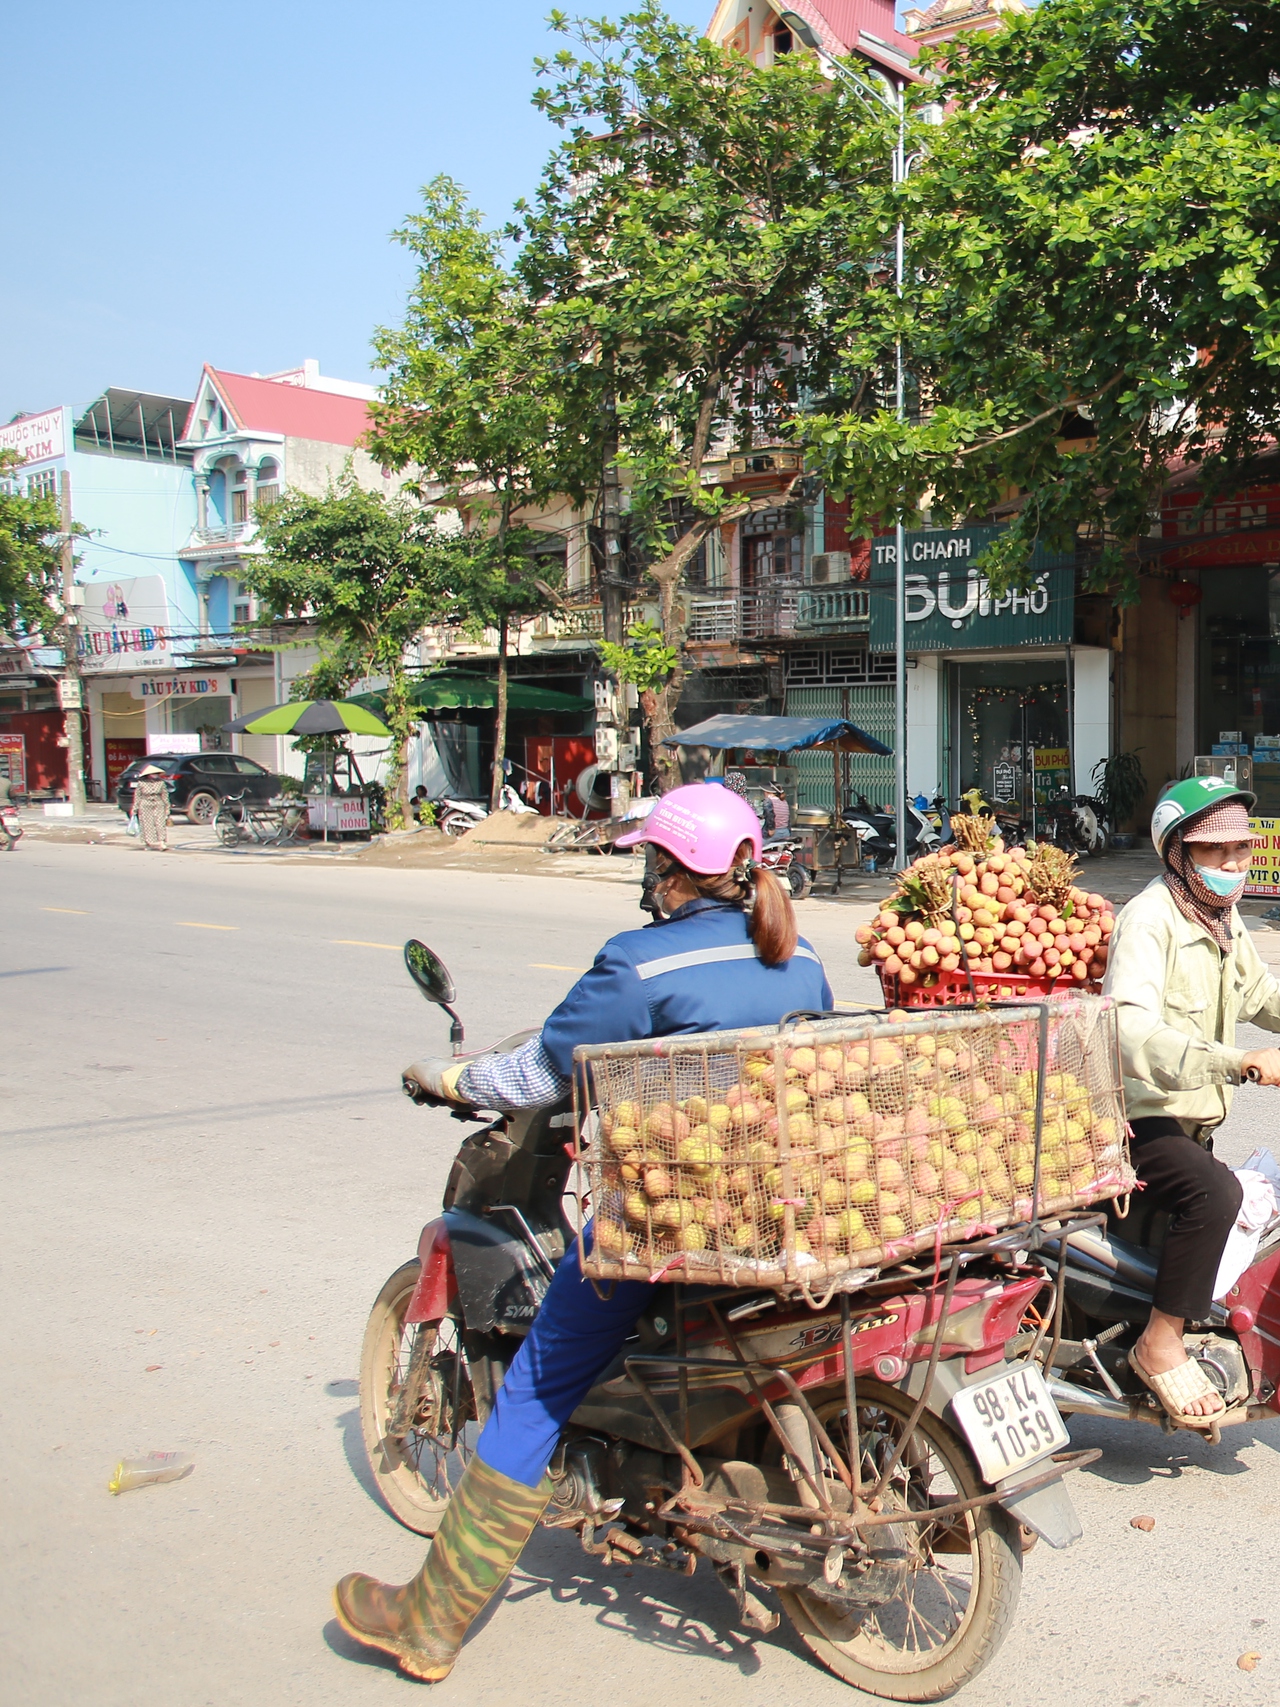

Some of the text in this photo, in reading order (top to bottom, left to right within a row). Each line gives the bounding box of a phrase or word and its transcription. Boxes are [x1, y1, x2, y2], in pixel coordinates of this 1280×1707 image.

[25, 440, 53, 460] KIM
[912, 538, 970, 561] CHANH
[1217, 541, 1260, 556] GIA
[995, 572, 1049, 615] PHỐ
[104, 623, 129, 653] TÂY
[132, 625, 166, 653] KID'S
[142, 677, 218, 696] DÂU TÂY KID'S
[1036, 750, 1069, 768] BỤI PHỐ
[1036, 772, 1051, 786] Trà
[341, 817, 367, 829] NÓNG
[1259, 820, 1274, 829] Nhi
[1249, 870, 1268, 883] VỊT
[504, 1305, 535, 1318] SYM
[859, 1314, 899, 1332] 110
[992, 1410, 1055, 1466] 1059
